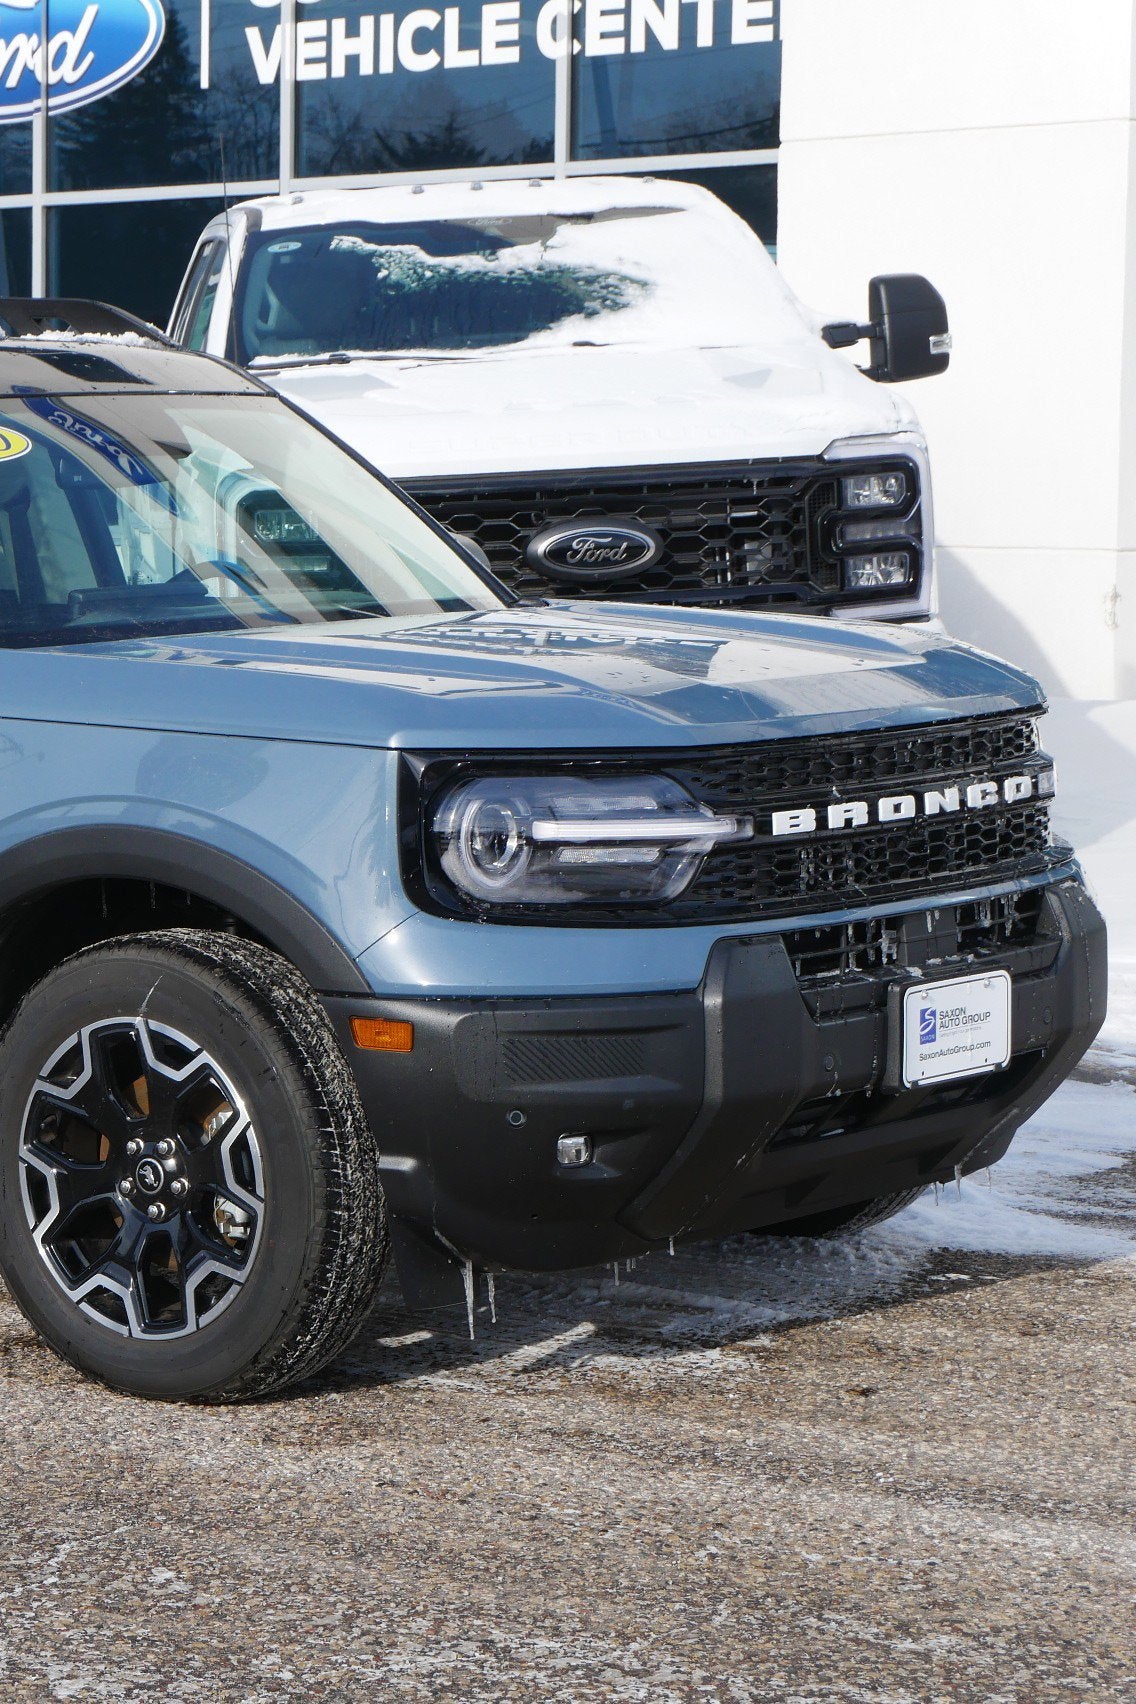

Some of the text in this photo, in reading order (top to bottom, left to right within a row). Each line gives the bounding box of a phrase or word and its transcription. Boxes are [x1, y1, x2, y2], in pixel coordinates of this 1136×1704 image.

[245, 0, 783, 85] VEHICLE CENTE
[566, 537, 628, 563] Ford
[772, 775, 1033, 836] BRONCO
[939, 1007, 966, 1020] SAXON
[939, 1011, 991, 1029] AUTO GROUP
[919, 1041, 991, 1061] SaxonAutoGroup.com
